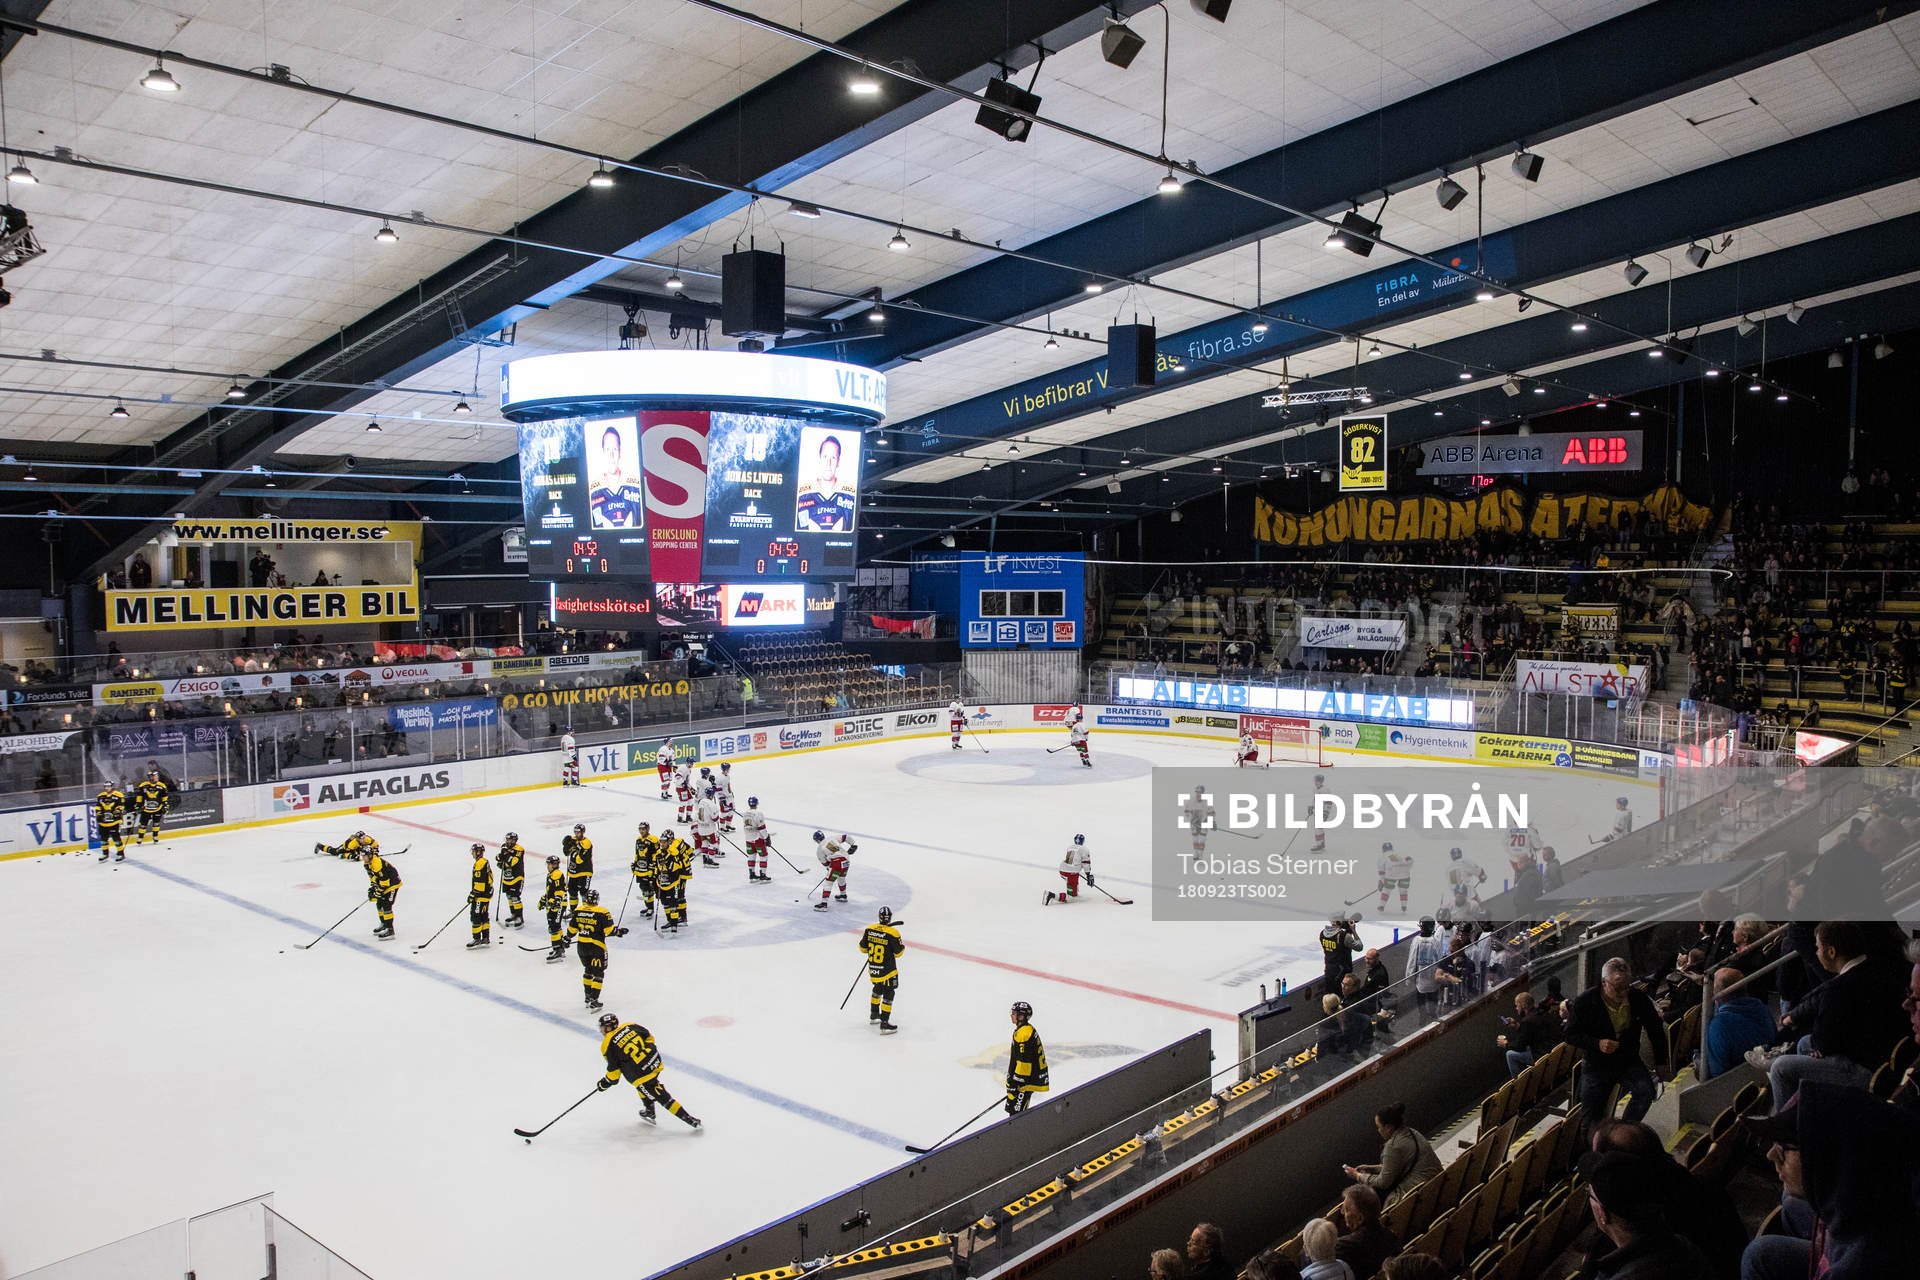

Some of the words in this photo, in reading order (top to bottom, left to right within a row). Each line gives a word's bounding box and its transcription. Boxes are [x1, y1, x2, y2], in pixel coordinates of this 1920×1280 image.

[1376, 274, 1419, 294] FIBRA
[1378, 297, 1391, 307] En
[1392, 290, 1407, 303] del
[1408, 288, 1420, 298] av
[1003, 397, 1020, 417] Vi
[1023, 378, 1094, 413] befibrar
[1187, 329, 1265, 361] fibra.se
[1350, 436, 1375, 463] 82
[1431, 446, 1474, 463] ABB
[1481, 446, 1543, 462] Arena
[1561, 437, 1628, 464] ABB
[652, 528, 698, 540] ERIKSLUND
[652, 541, 678, 549] SHOPPING
[679, 541, 698, 549] CENTER
[757, 559, 765, 574] 0
[800, 559, 808, 574] 0
[984, 554, 1009, 573] LF
[1012, 555, 1062, 570] INVEST
[116, 593, 347, 624] MELLINGER
[361, 592, 416, 616] BIL
[740, 599, 797, 612] MARK
[1306, 624, 1353, 643] Carlsson
[395, 668, 429, 677] VEOLIA
[27, 692, 67, 701] Forslunds
[69, 690, 89, 699] Tvätt
[110, 688, 156, 698] RAMIRENT
[179, 681, 219, 693] EXIGO
[523, 692, 548, 709] GO
[552, 690, 581, 706] VIK
[584, 685, 649, 705] HOCKEY
[650, 682, 673, 696] GO
[1152, 680, 1247, 706] ALFAB
[1105, 707, 1162, 716] BRANTESTIG
[1318, 690, 1430, 720] ALFAB
[110, 732, 149, 750] PAX
[194, 726, 230, 743] PAX
[1405, 734, 1468, 749] Hygienteknik
[1479, 735, 1568, 751] Gokartarena
[587, 747, 620, 773] vlt
[633, 744, 697, 765] Assblin
[1491, 748, 1552, 762] DALARNA
[317, 770, 450, 804] ALFAGLAS
[26, 811, 84, 846] vlt
[1510, 834, 1526, 847] 70
[1322, 938, 1337, 949] FOTO
[623, 1035, 652, 1065] 27
